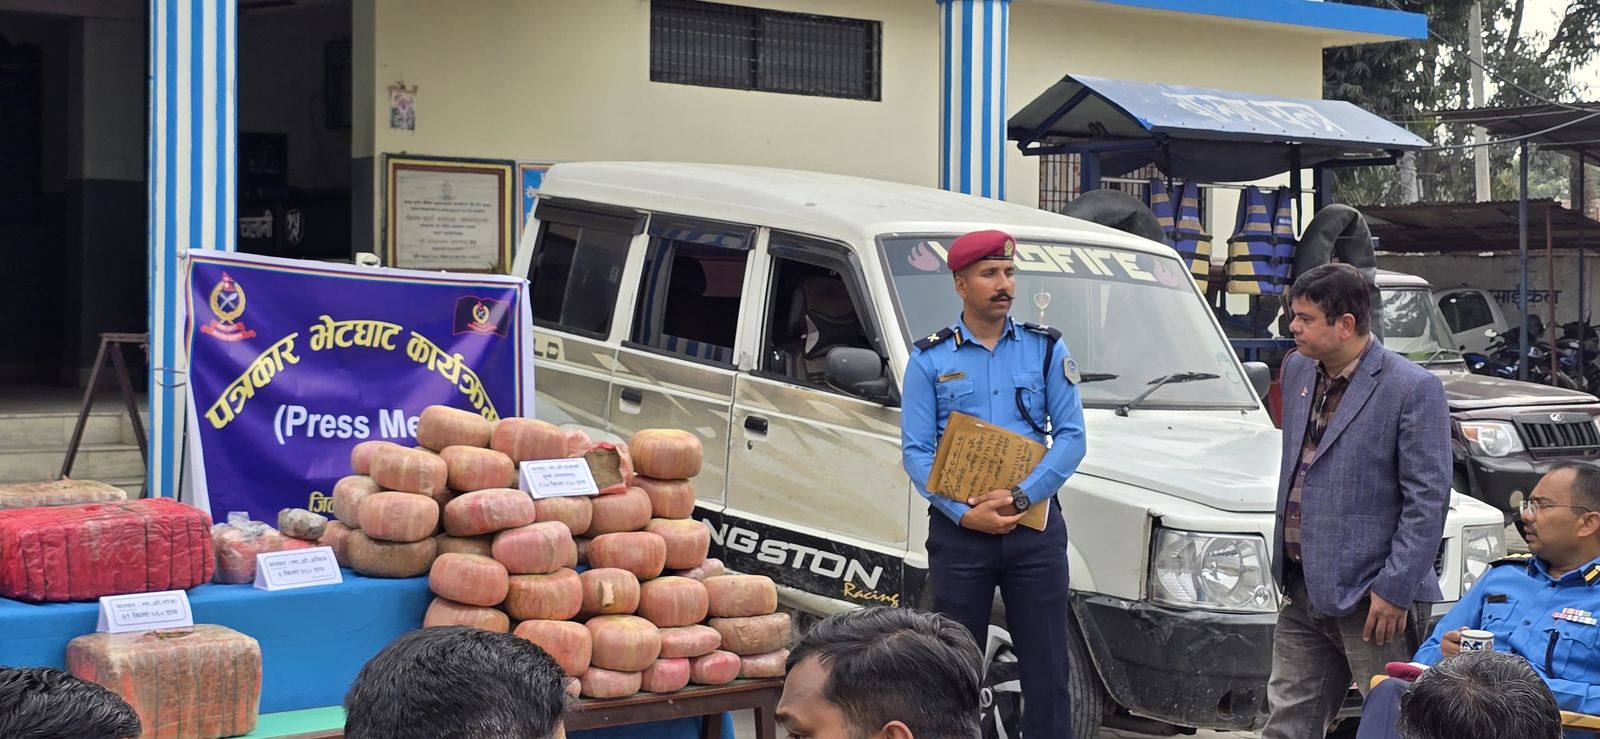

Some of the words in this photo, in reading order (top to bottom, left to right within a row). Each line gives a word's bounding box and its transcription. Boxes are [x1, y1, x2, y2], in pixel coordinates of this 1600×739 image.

[533, 337, 560, 360] LD
[205, 331, 301, 430] पत्रकार
[309, 315, 404, 352] भेटघाट
[273, 403, 371, 445] (Press
[379, 408, 421, 439] Me
[308, 490, 335, 513] जि
[702, 517, 884, 590] NGSTON
[843, 582, 899, 608] Racing
